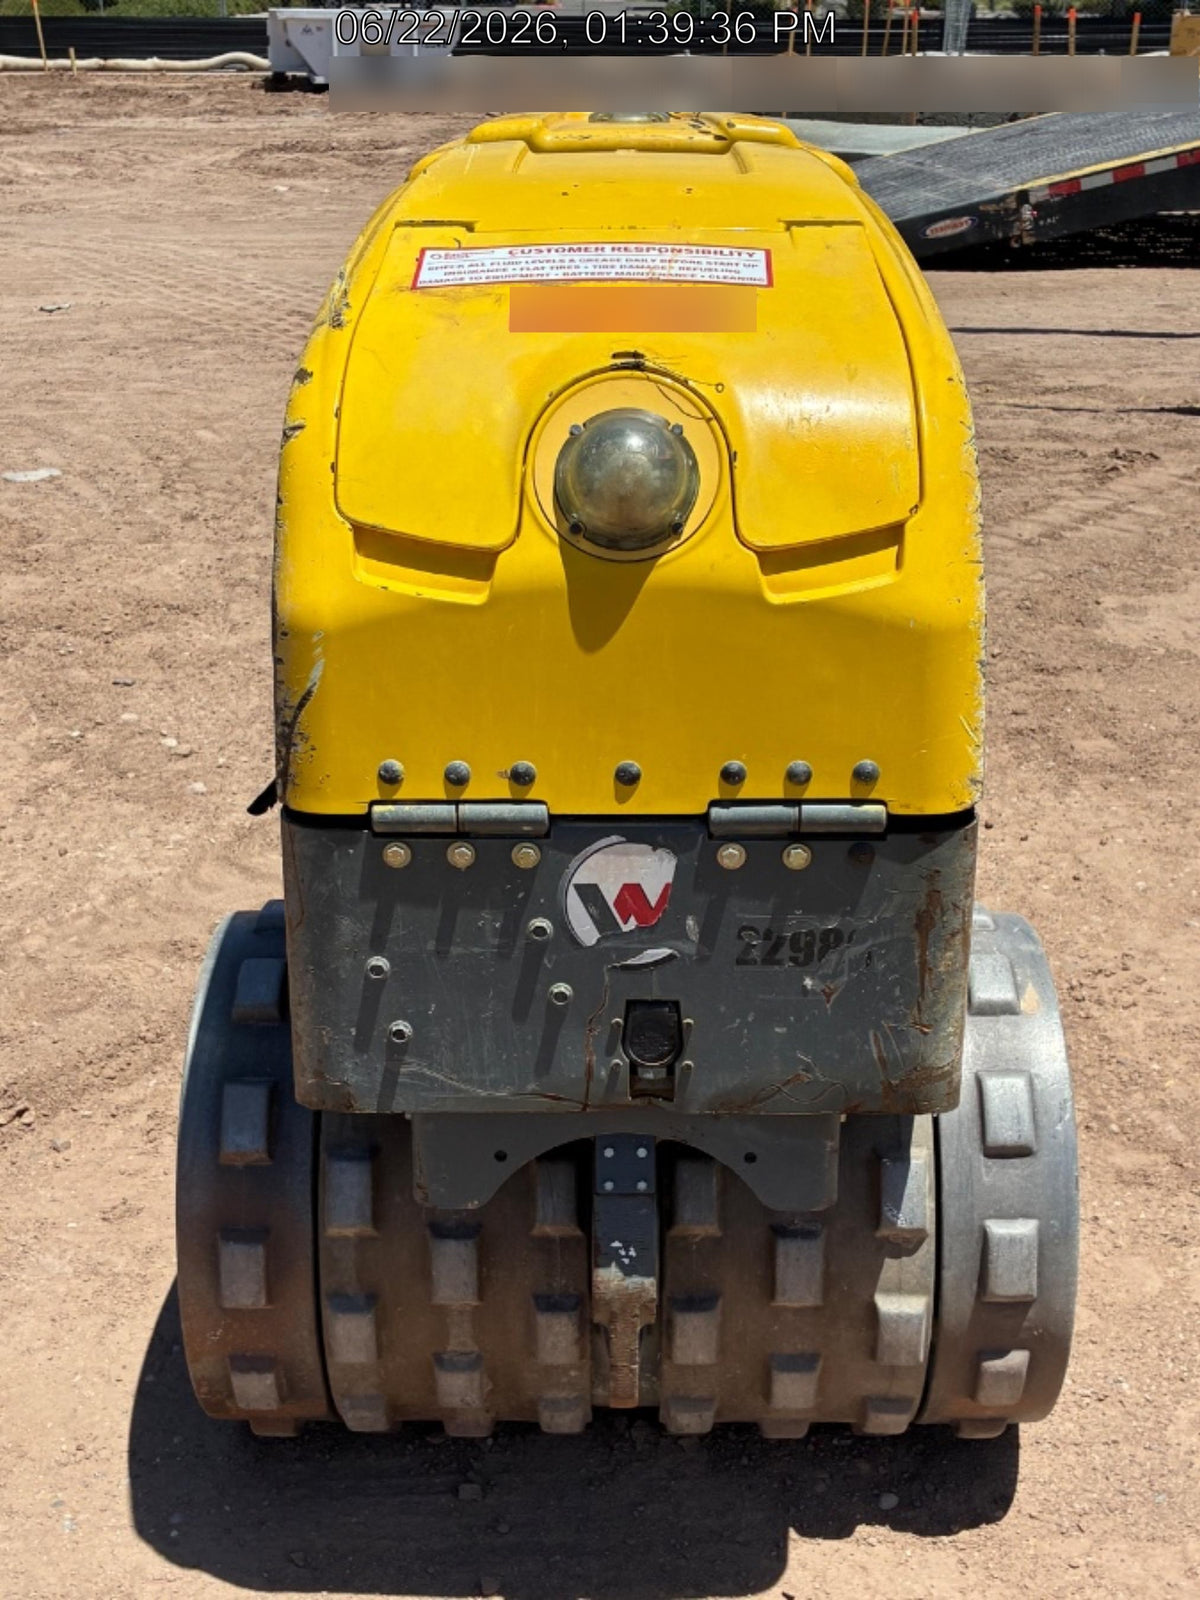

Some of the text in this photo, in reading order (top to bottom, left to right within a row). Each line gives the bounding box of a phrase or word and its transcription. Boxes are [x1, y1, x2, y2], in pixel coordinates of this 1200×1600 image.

[508, 246, 756, 258] CUSTOMER RESPONSIBILITY
[706, 260, 740, 268] START
[562, 270, 613, 278] BATTERY
